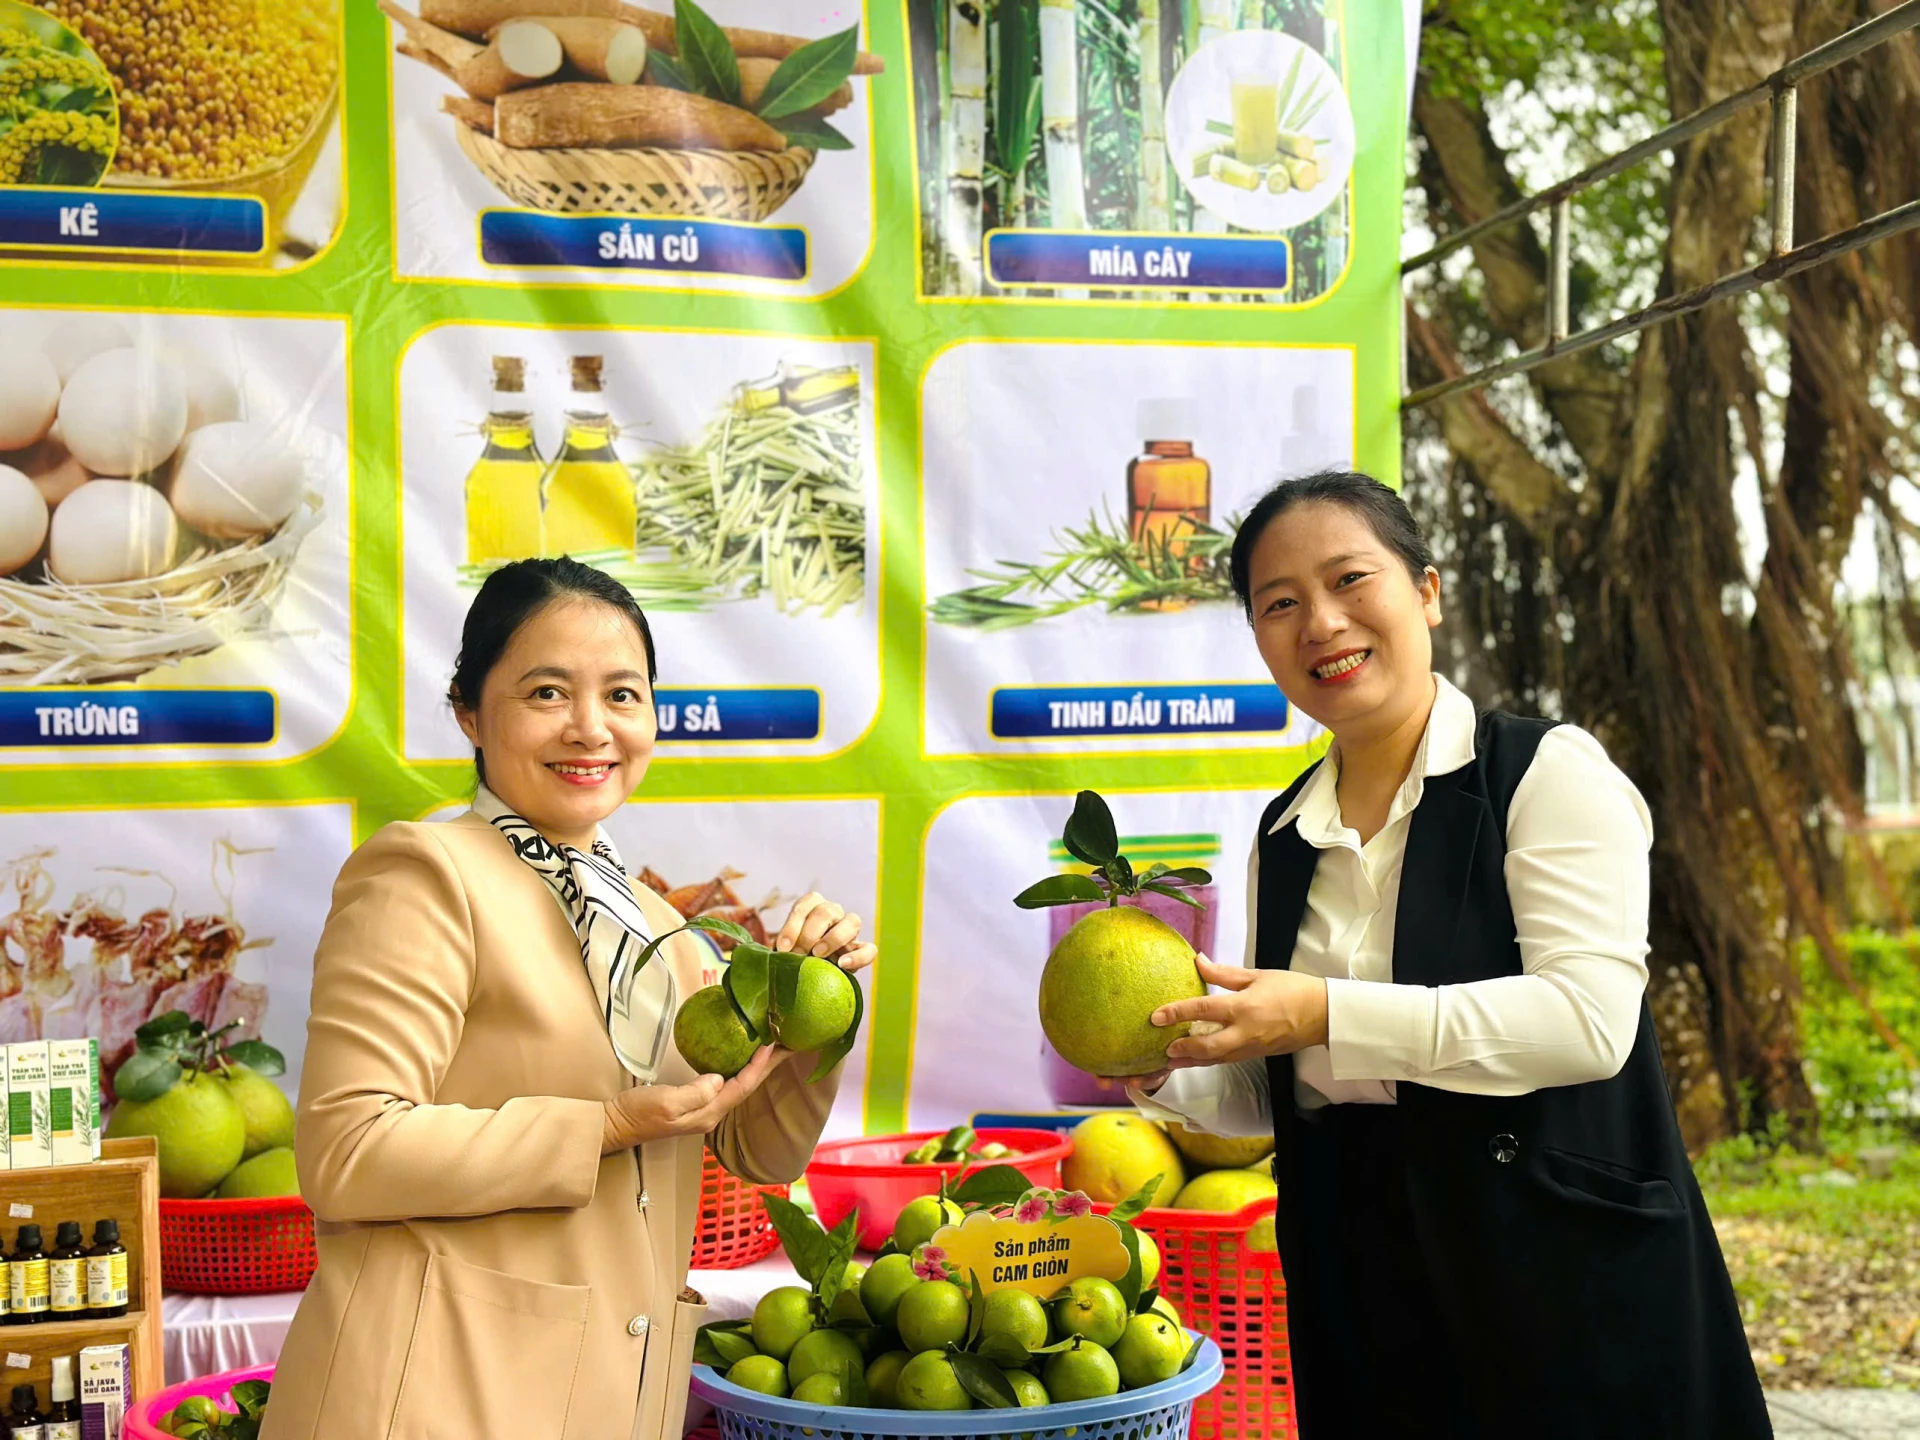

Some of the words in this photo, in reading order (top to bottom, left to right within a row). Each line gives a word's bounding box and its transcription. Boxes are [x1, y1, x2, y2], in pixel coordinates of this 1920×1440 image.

[59, 202, 99, 237] KÊ
[598, 222, 656, 261] SẮN
[662, 226, 699, 263] CỦ
[1089, 245, 1138, 277] MÍA
[1144, 245, 1192, 278] CÂY
[35, 701, 139, 736] TRỨNG
[683, 695, 721, 732] SẢ
[1049, 701, 1105, 728] TINH
[1167, 693, 1235, 726] TRÀM
[994, 1238, 1024, 1258] Sản
[1028, 1233, 1070, 1256] phẩm
[993, 1263, 1028, 1283] CAM
[1033, 1256, 1069, 1279] GIÒN
[96, 1378, 116, 1388] JAVA
[101, 1385, 121, 1393] OANH
